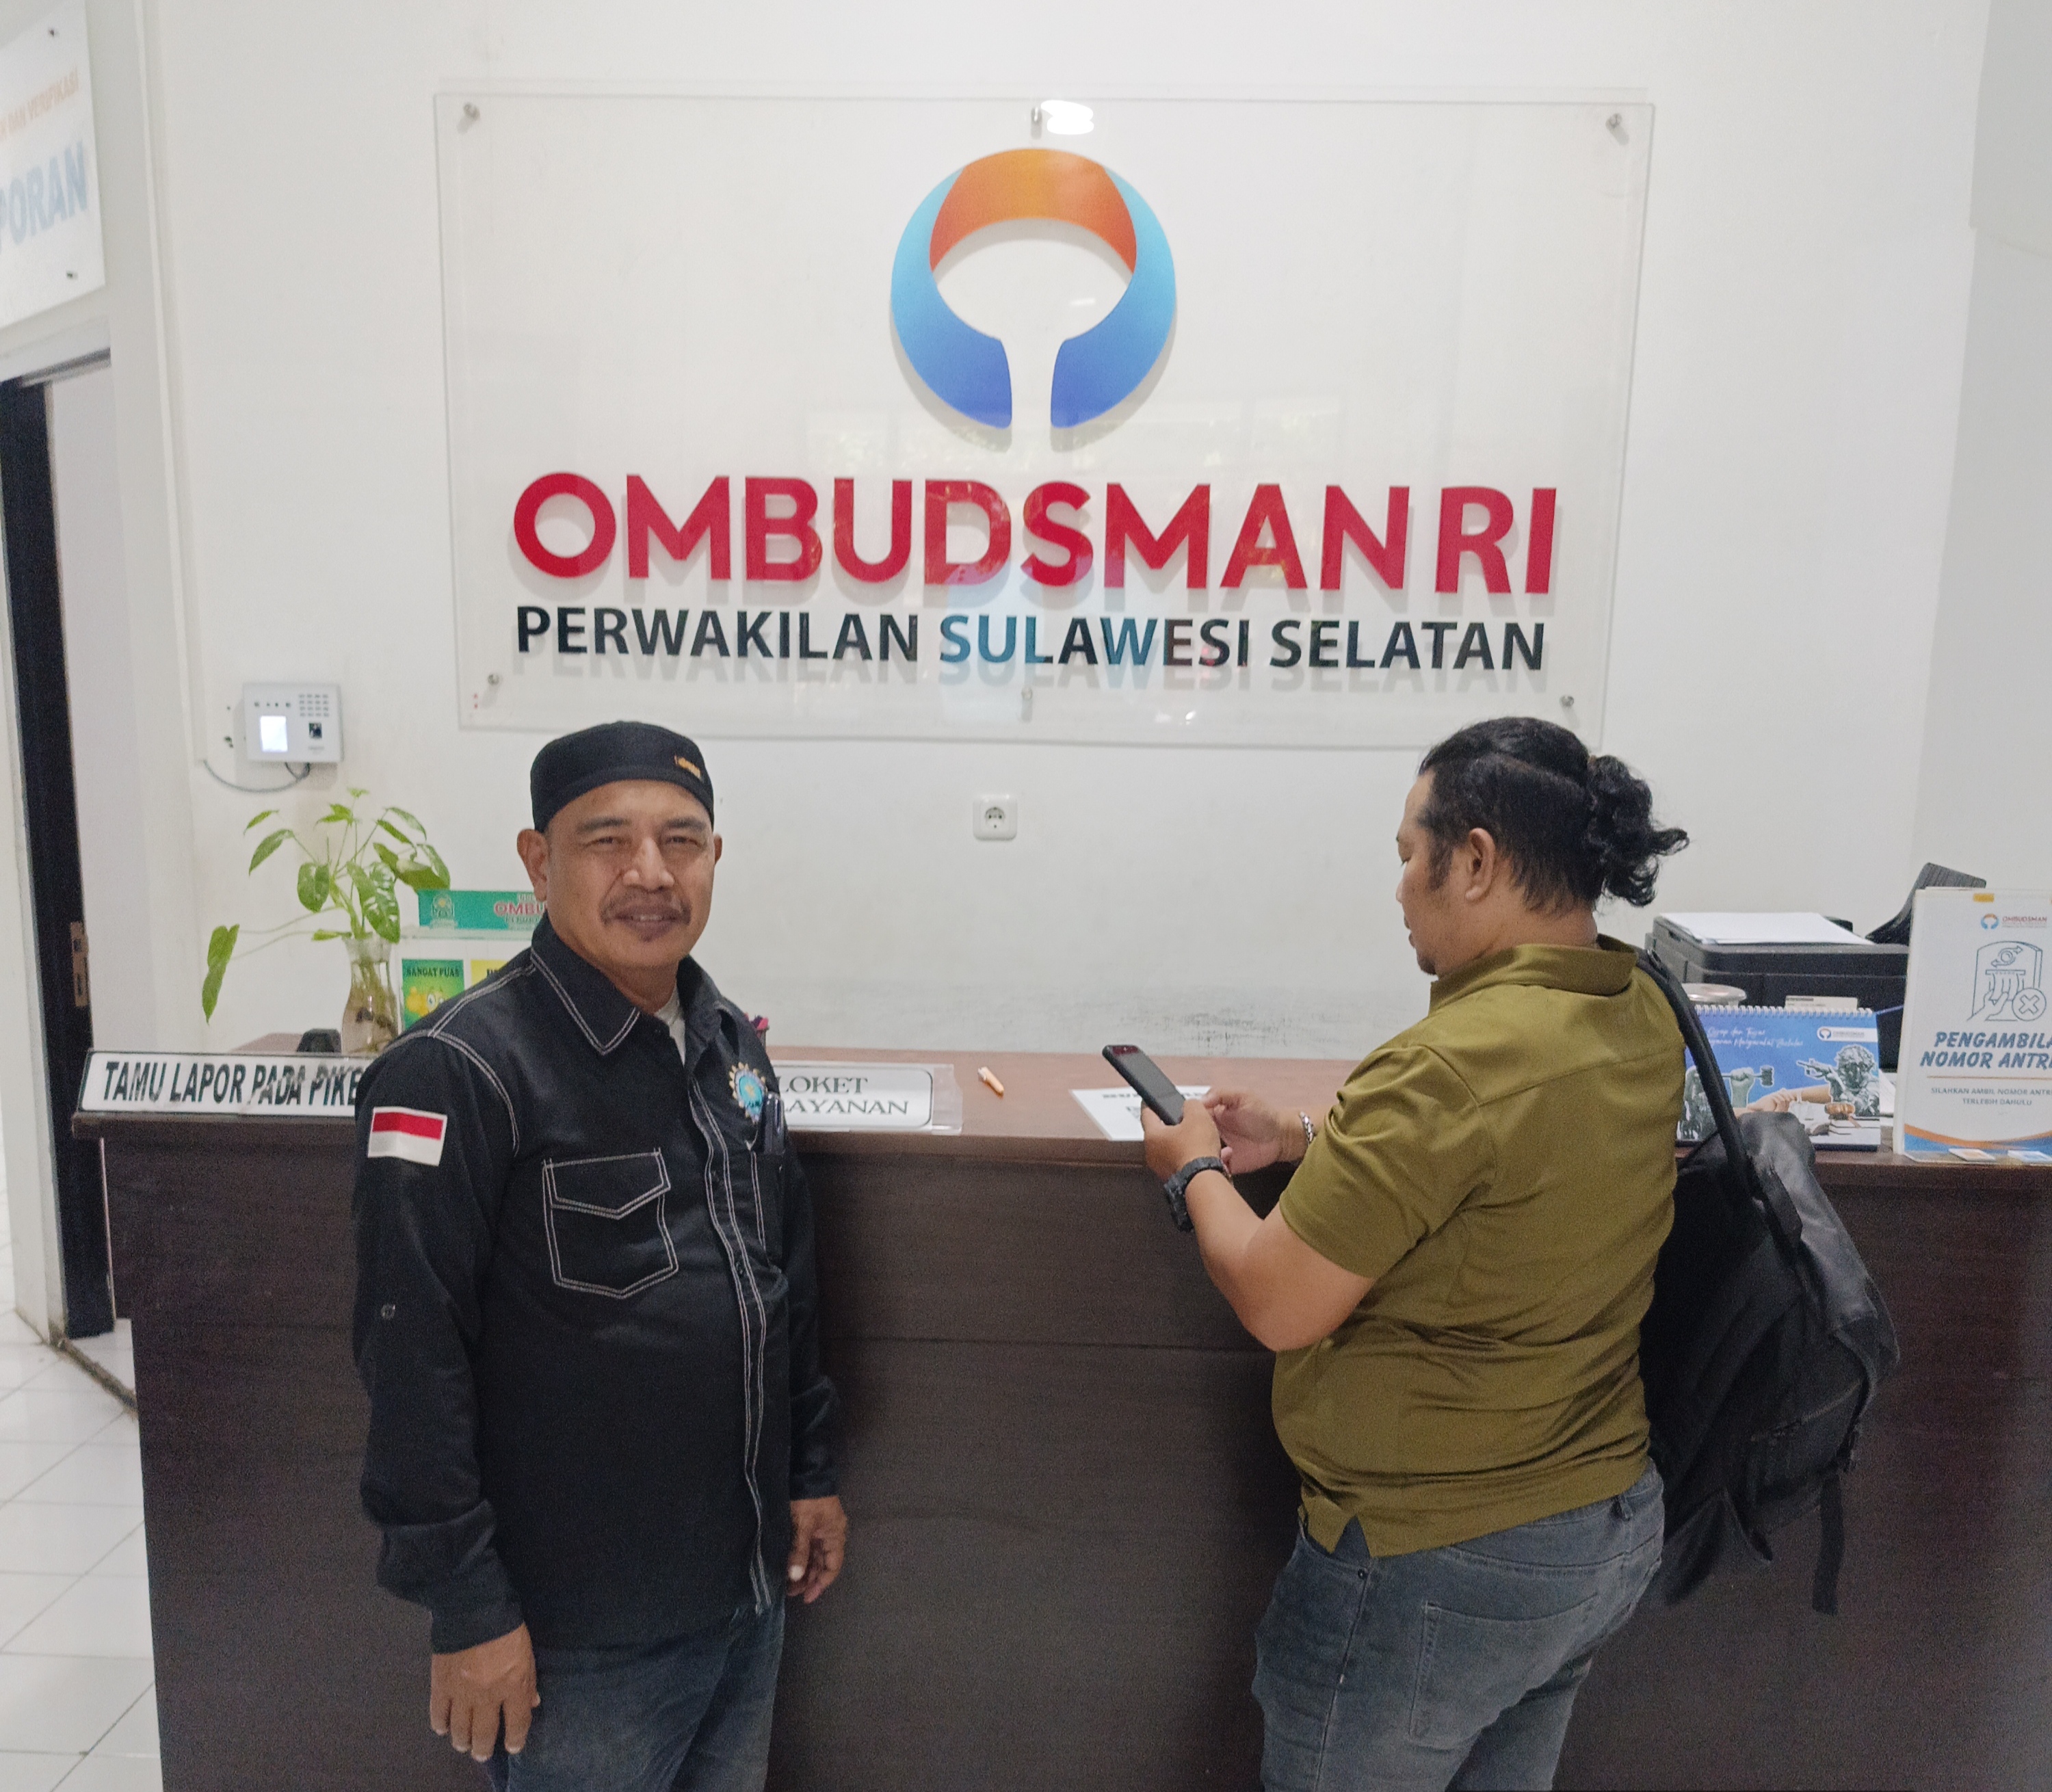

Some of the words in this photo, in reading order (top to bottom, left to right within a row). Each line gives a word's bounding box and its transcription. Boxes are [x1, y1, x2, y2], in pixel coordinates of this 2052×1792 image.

[514, 471, 1410, 590] OMBUDSMAN
[1435, 486, 1557, 594] RI
[516, 606, 918, 661] PERWAKILAN
[939, 614, 1250, 667] SULAWESI
[1270, 618, 1545, 670] SELATAN
[494, 901, 546, 917] OMBU
[1919, 1051, 1992, 1069] NOMOR
[1998, 1052, 2052, 1070] ANTR
[103, 1060, 167, 1103] TAMU
[169, 1062, 246, 1104] LAPOR
[248, 1064, 306, 1106] PADA
[308, 1066, 364, 1106] PIKE
[785, 1098, 908, 1115] AYANAN
